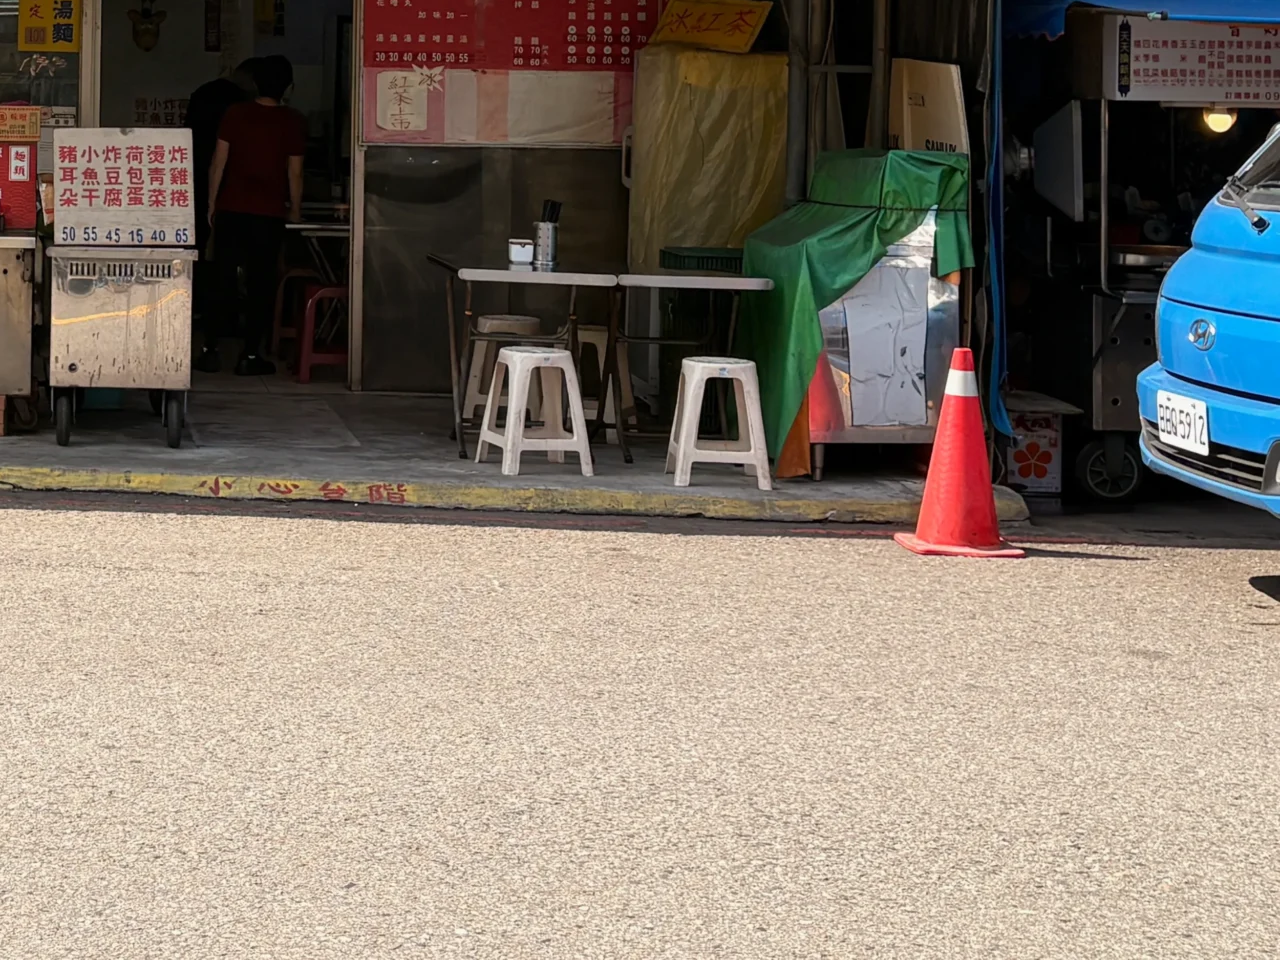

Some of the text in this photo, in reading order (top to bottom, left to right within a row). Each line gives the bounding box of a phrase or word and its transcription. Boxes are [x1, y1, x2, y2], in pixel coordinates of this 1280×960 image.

[58, 145, 78, 207] 豬耳朵
[81, 145, 100, 242] 小魚干 55
[102, 145, 123, 243] 炸豆腐 45
[125, 145, 145, 244] 荷包蛋 15
[147, 145, 167, 242] 燙青菜 40
[168, 145, 189, 244] 炸雞捲 65
[62, 226, 76, 242] 50
[198, 476, 408, 504] 小心台階
